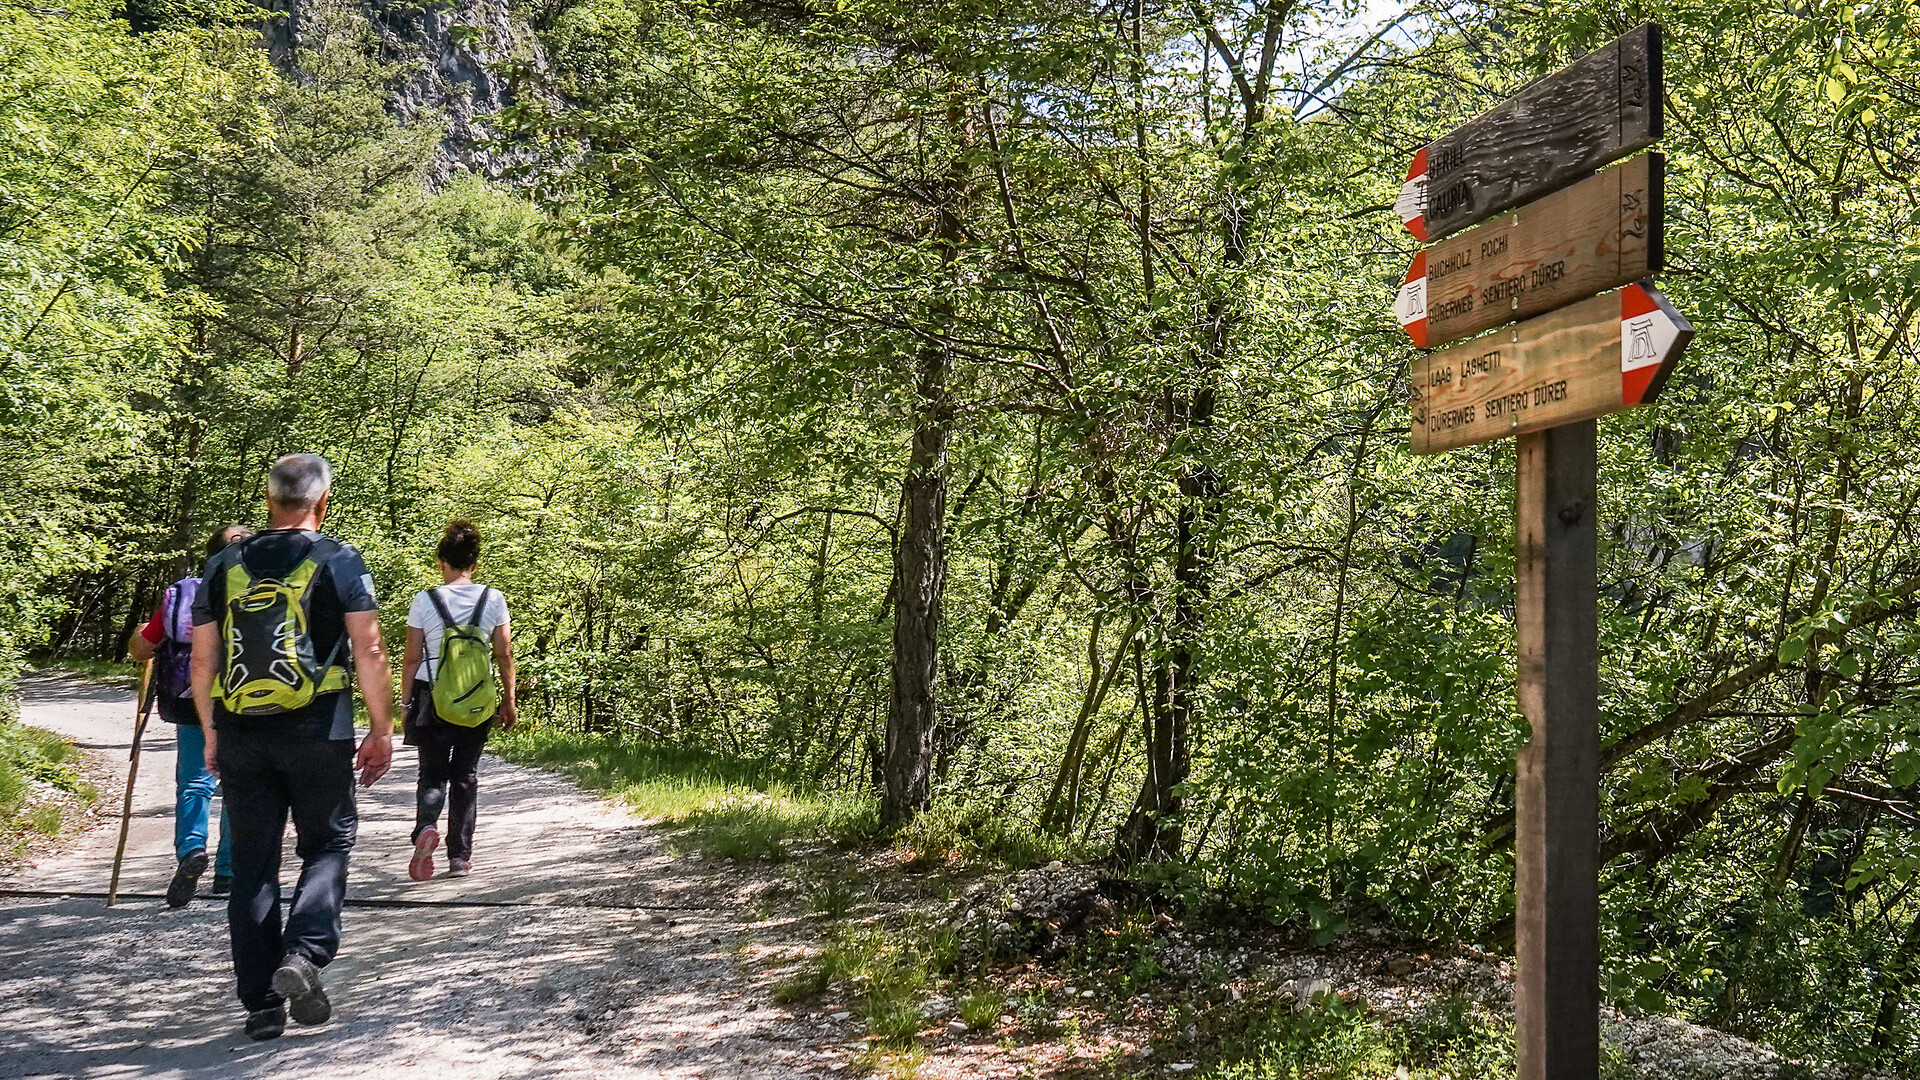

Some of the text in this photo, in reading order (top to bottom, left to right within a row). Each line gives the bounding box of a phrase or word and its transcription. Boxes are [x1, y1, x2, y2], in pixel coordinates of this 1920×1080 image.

[1428, 144, 1465, 180] GFRILL
[1428, 181, 1469, 219] CAURIA
[1429, 233, 1508, 281] BUCHHOLZ POCHI
[1429, 260, 1565, 325] DÜRERWEG SENTIERO DÜRER
[1431, 350, 1501, 387] LAAG LAGHETTI
[1431, 380, 1568, 432] DÜRERWEG SENTIERO DÜRER
